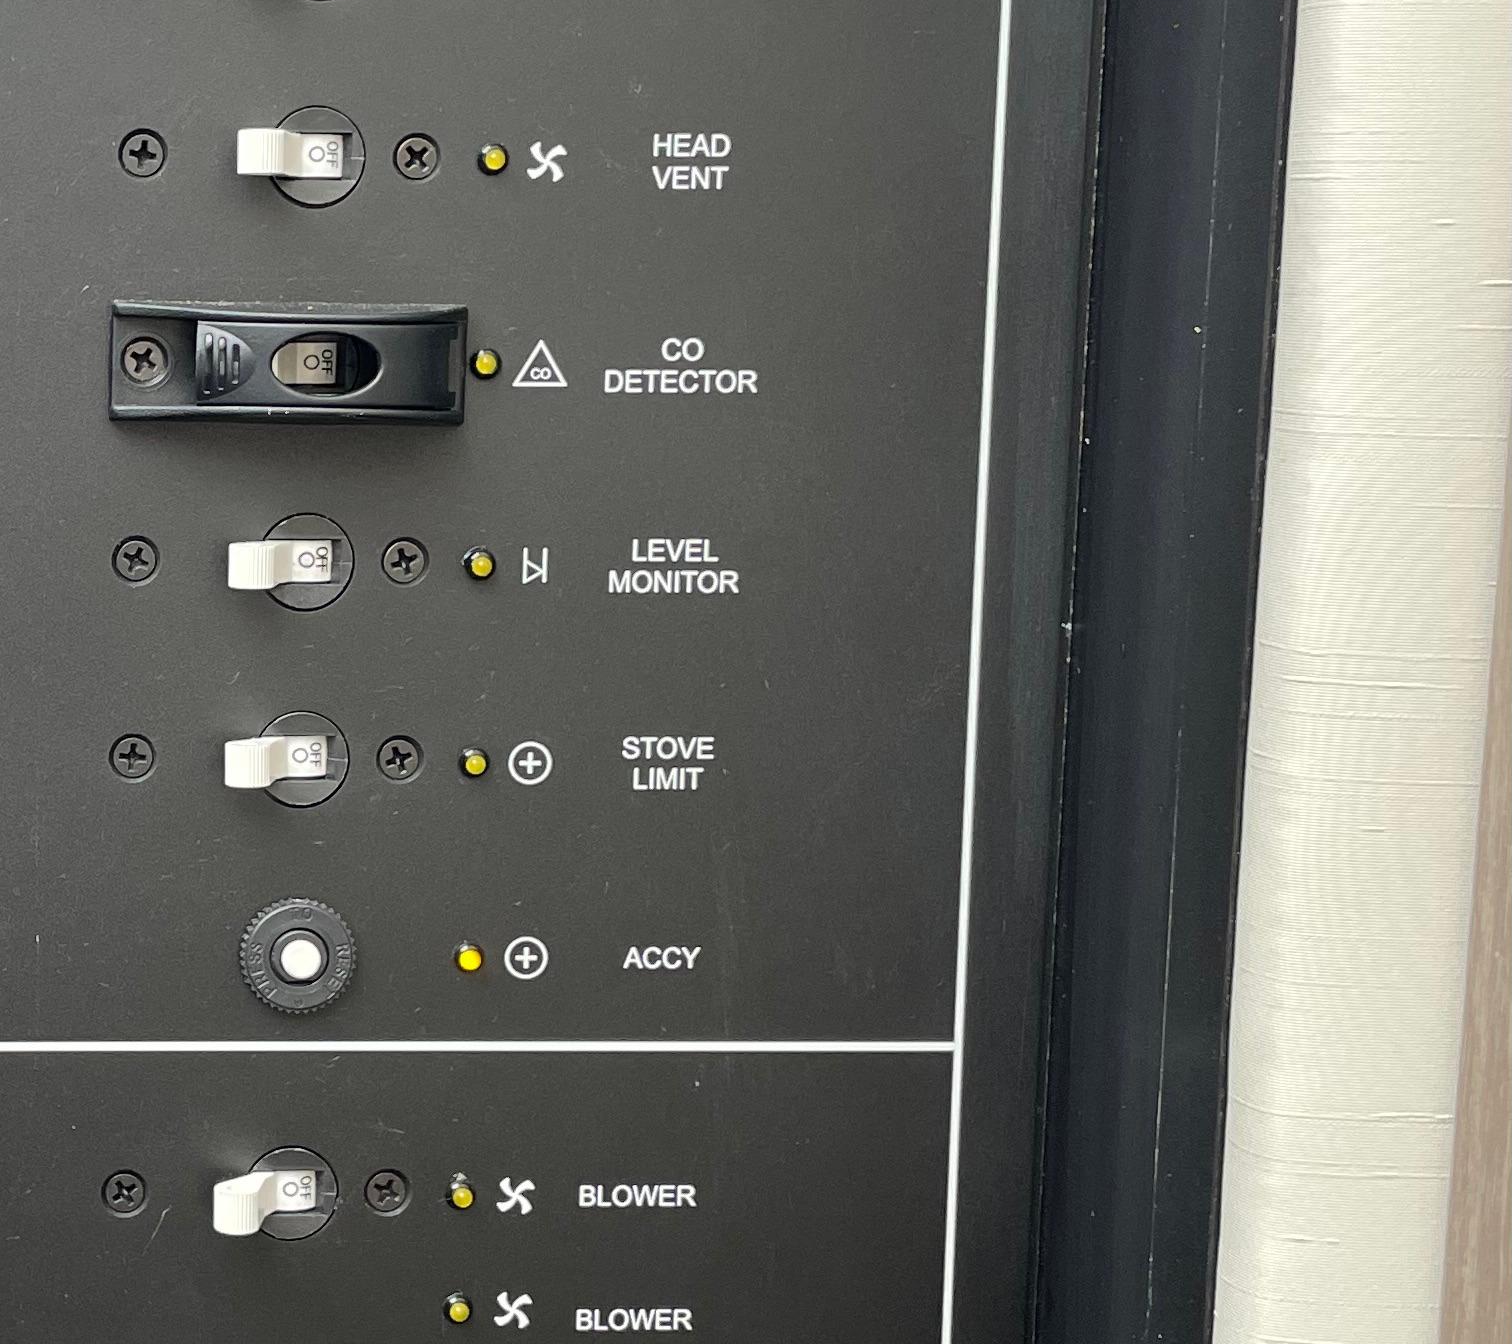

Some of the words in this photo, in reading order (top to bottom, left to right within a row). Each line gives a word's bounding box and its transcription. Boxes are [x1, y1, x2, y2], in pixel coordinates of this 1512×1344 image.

[652, 133, 732, 158] HEAD
[651, 165, 730, 190] VENT
[661, 337, 705, 362] CO
[530, 367, 552, 380] CO
[604, 369, 758, 394] DETECTOR
[631, 538, 720, 563] LEVEL
[608, 569, 739, 594] MONITOR
[621, 735, 715, 760] STOVE
[632, 766, 705, 791] LIMIT
[622, 946, 702, 970] ACCY
[578, 1184, 697, 1208] BLOWER
[575, 1308, 693, 1332] BLOWER
